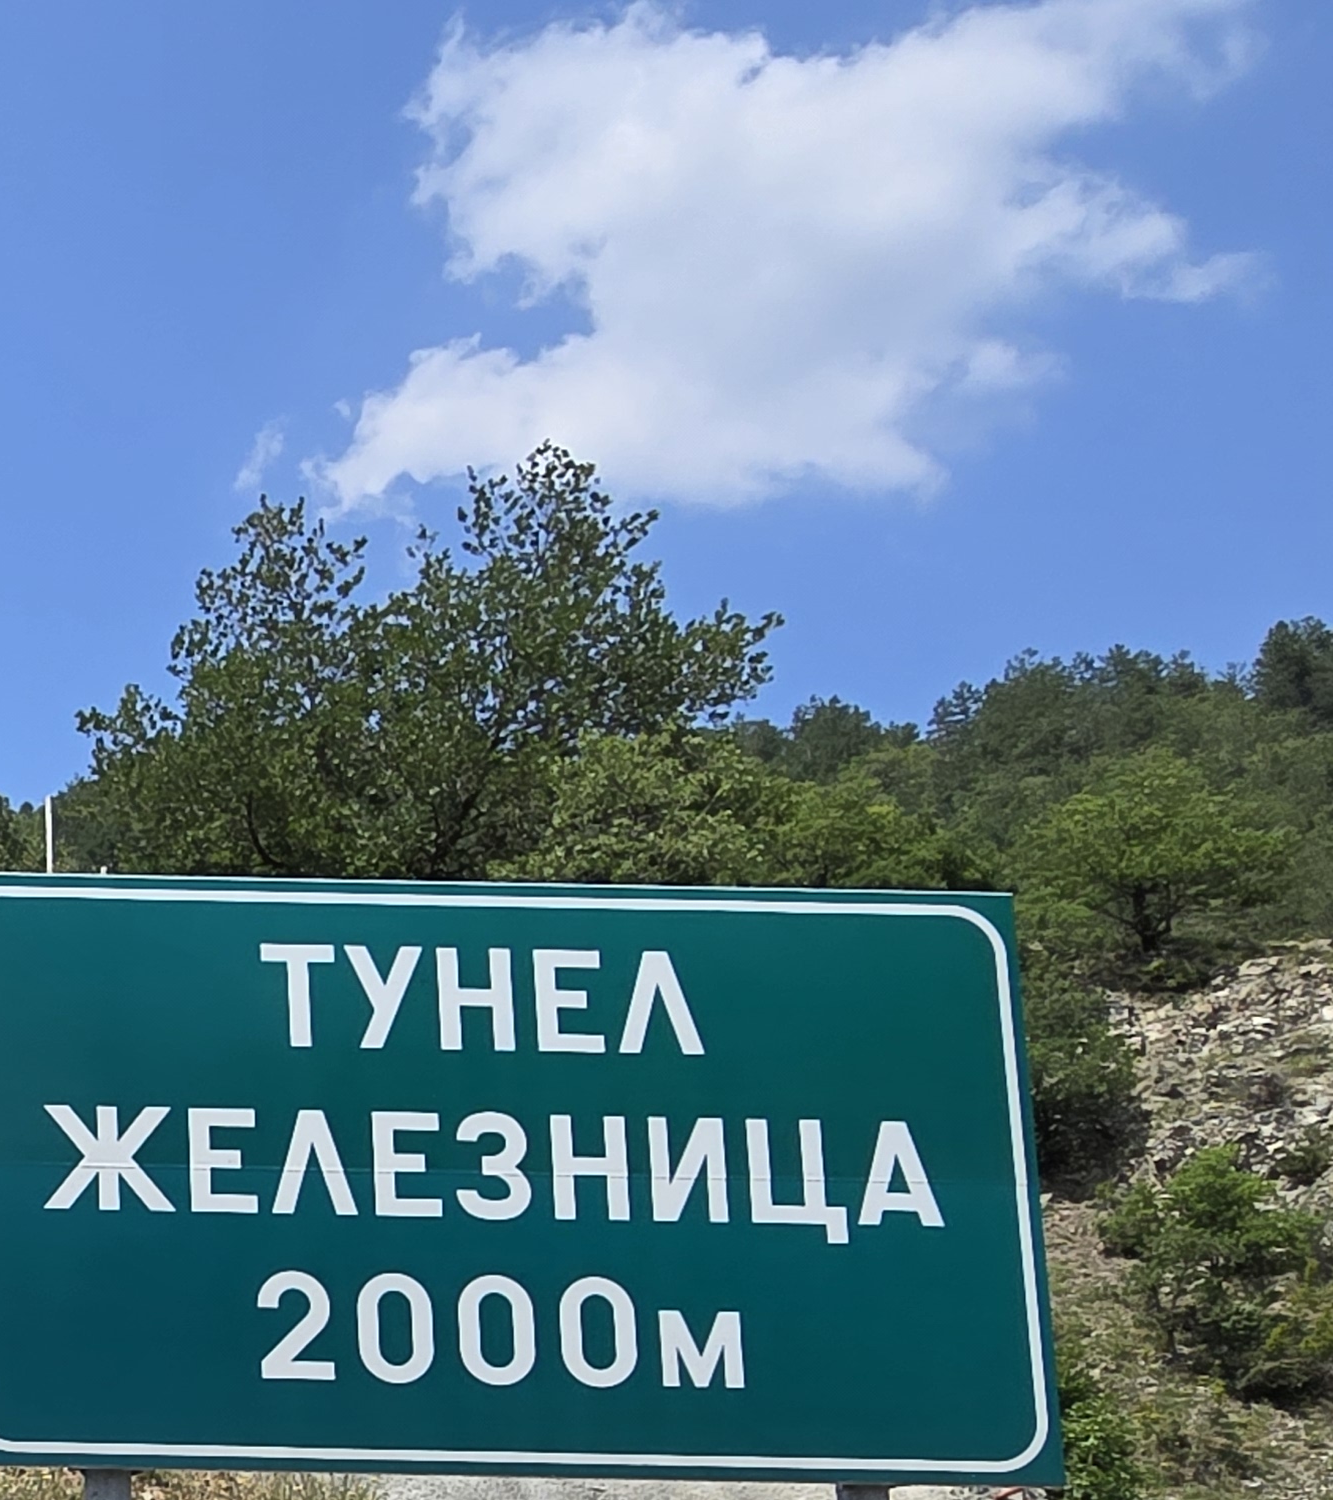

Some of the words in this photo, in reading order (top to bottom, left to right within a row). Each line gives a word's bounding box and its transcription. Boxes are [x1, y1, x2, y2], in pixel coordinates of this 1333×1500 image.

[259, 943, 705, 1055] ТУНЕЛ
[43, 1104, 946, 1244] ЖЕЛЕЗНИЦА
[257, 1270, 745, 1389] 2000м
